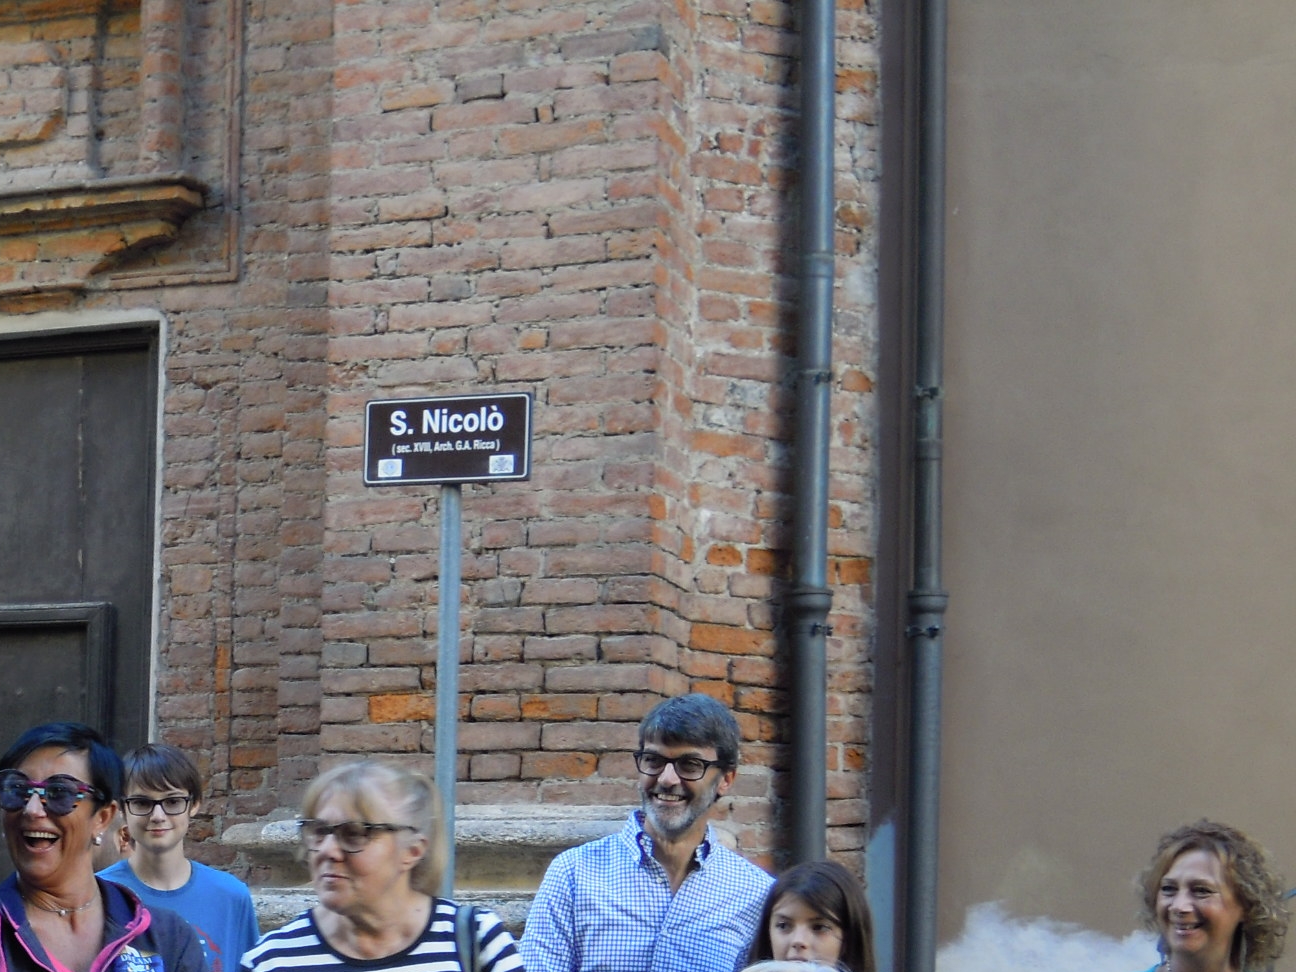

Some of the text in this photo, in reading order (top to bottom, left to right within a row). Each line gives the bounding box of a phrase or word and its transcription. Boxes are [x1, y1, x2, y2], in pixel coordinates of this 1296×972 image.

[390, 405, 504, 436] S. Nicolò
[434, 441, 454, 452] Arch.
